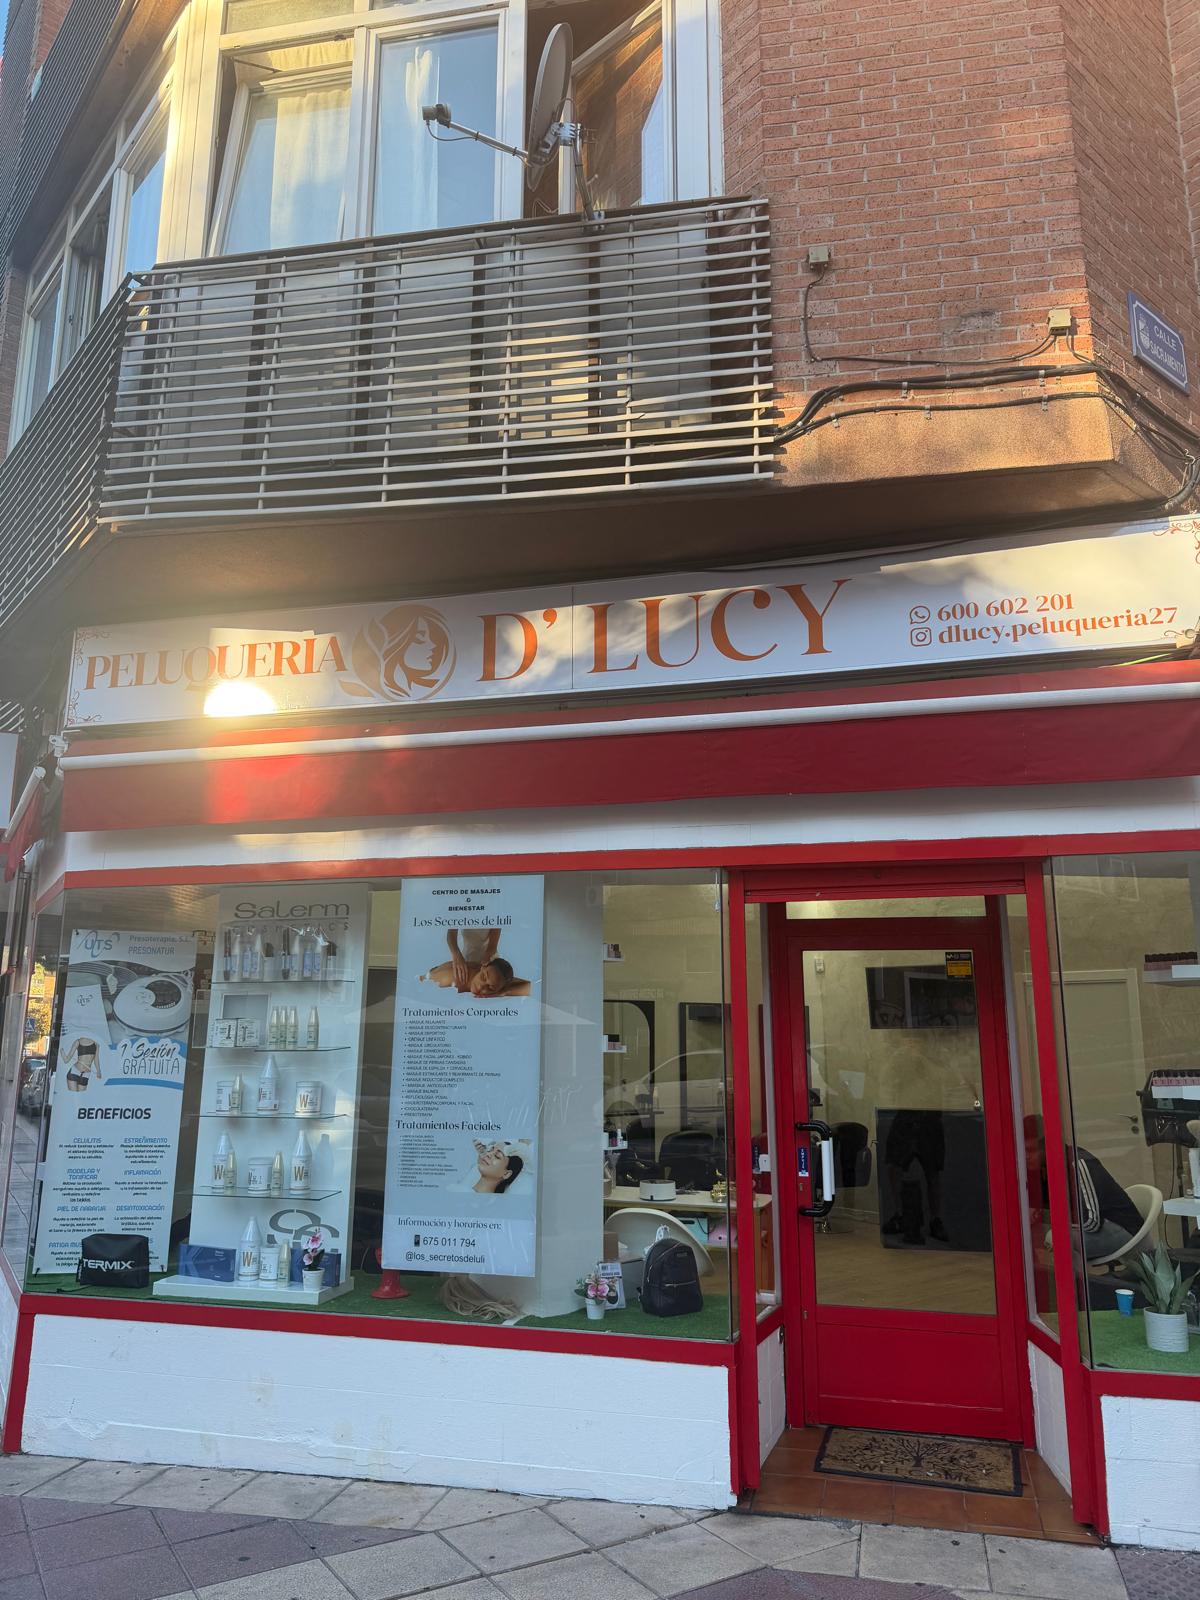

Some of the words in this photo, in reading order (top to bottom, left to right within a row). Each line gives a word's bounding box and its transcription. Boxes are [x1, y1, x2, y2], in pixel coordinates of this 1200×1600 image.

[1153, 325, 1177, 351] CALLE
[1149, 340, 1185, 377] SACRAMENTO
[937, 601, 979, 622] 600
[985, 597, 1029, 617] 602
[1035, 593, 1075, 612] 201
[476, 578, 853, 682] D'LUCY
[938, 606, 1178, 644] dlucy.peluqueria27
[234, 900, 350, 919] Salerm
[413, 917, 433, 927] Los
[434, 916, 480, 926] Secretos
[481, 915, 495, 926] de
[496, 915, 512, 926] luli
[402, 1007, 465, 1017] Tratamientos
[466, 1007, 518, 1018] Corporales
[132, 1043, 176, 1058] Sesión
[122, 1057, 180, 1075] GRATUITA
[77, 1108, 152, 1120] BENEFICIOS
[396, 1119, 460, 1130] Tratamientos
[461, 1120, 502, 1131] Faciales
[397, 1217, 446, 1228] Información
[447, 1221, 453, 1229] y
[454, 1219, 488, 1229] horarios
[489, 1222, 502, 1230] en:
[422, 1236, 439, 1246] 675
[441, 1237, 457, 1246] 011
[460, 1237, 476, 1248] 794
[405, 1251, 486, 1264] @los_secretosdeluli
[82, 1258, 133, 1272] TERMIX
